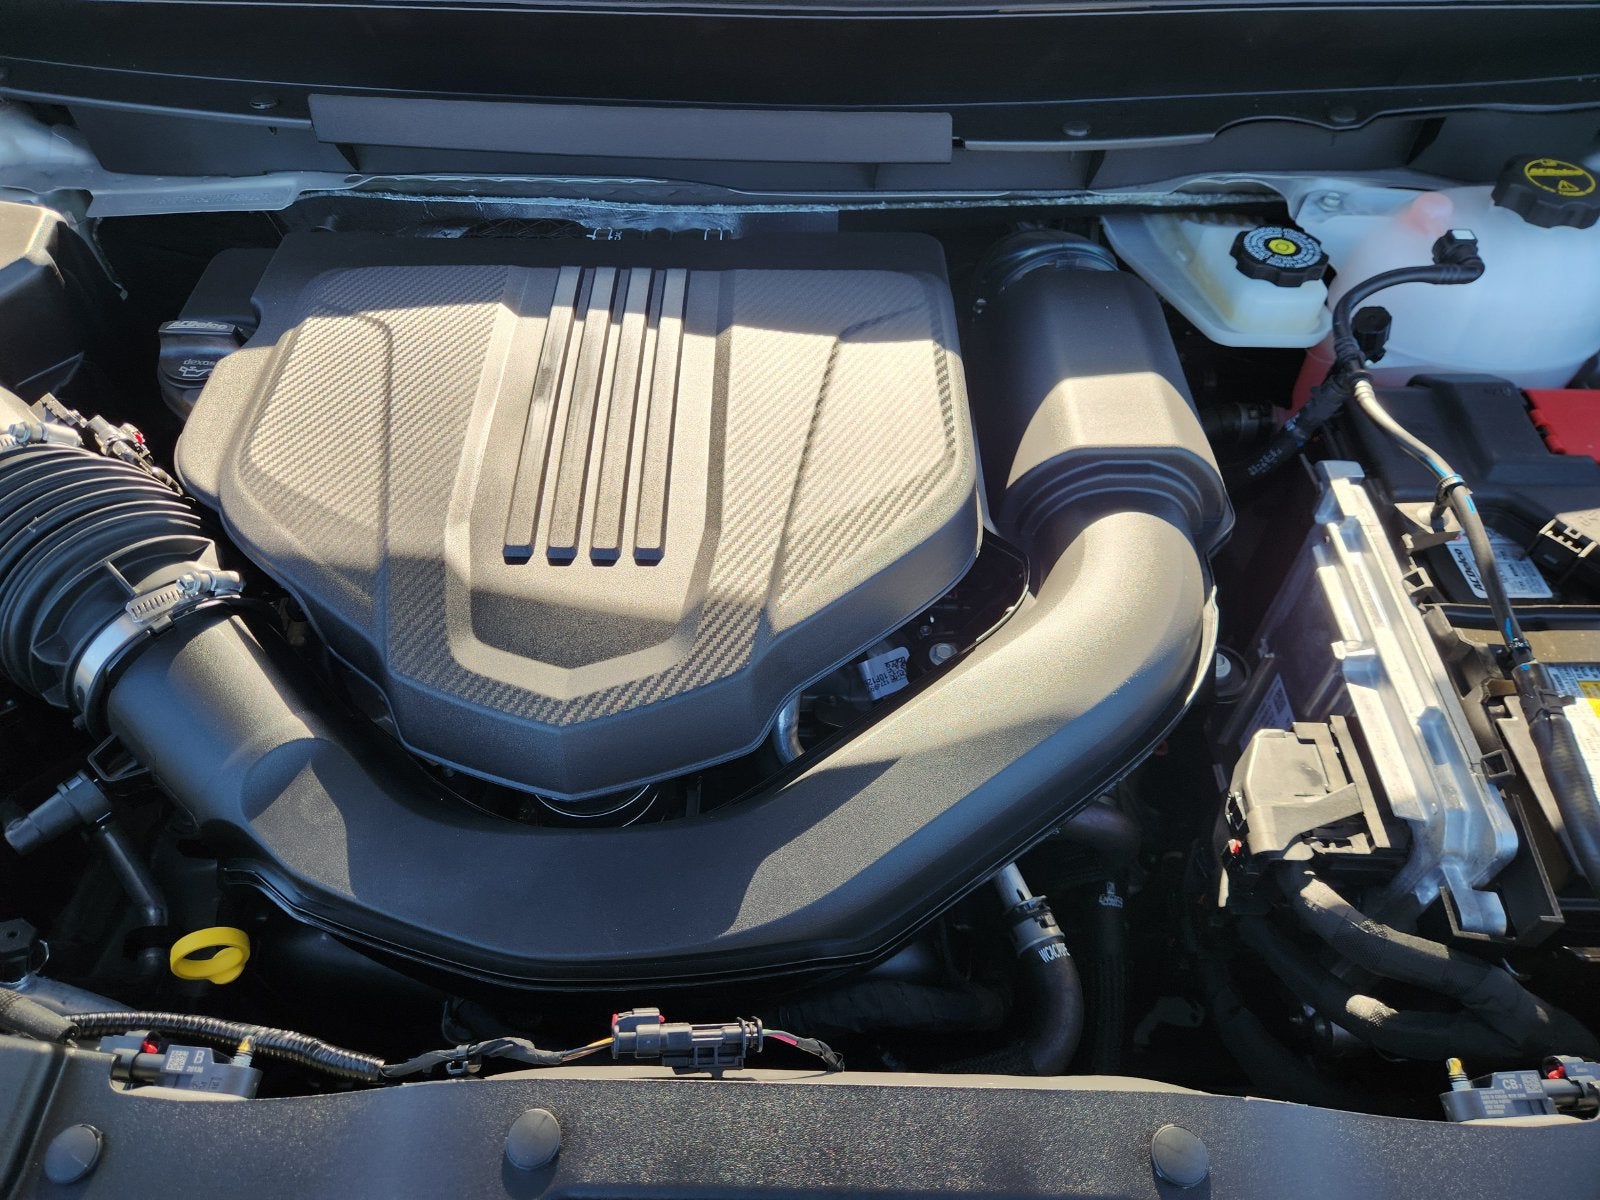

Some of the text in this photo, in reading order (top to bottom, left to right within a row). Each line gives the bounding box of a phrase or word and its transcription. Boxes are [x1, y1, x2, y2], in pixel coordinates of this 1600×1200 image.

[165, 320, 228, 330] ACDelco
[1454, 548, 1485, 591] ACDelco
[1502, 1079, 1519, 1090] CB
